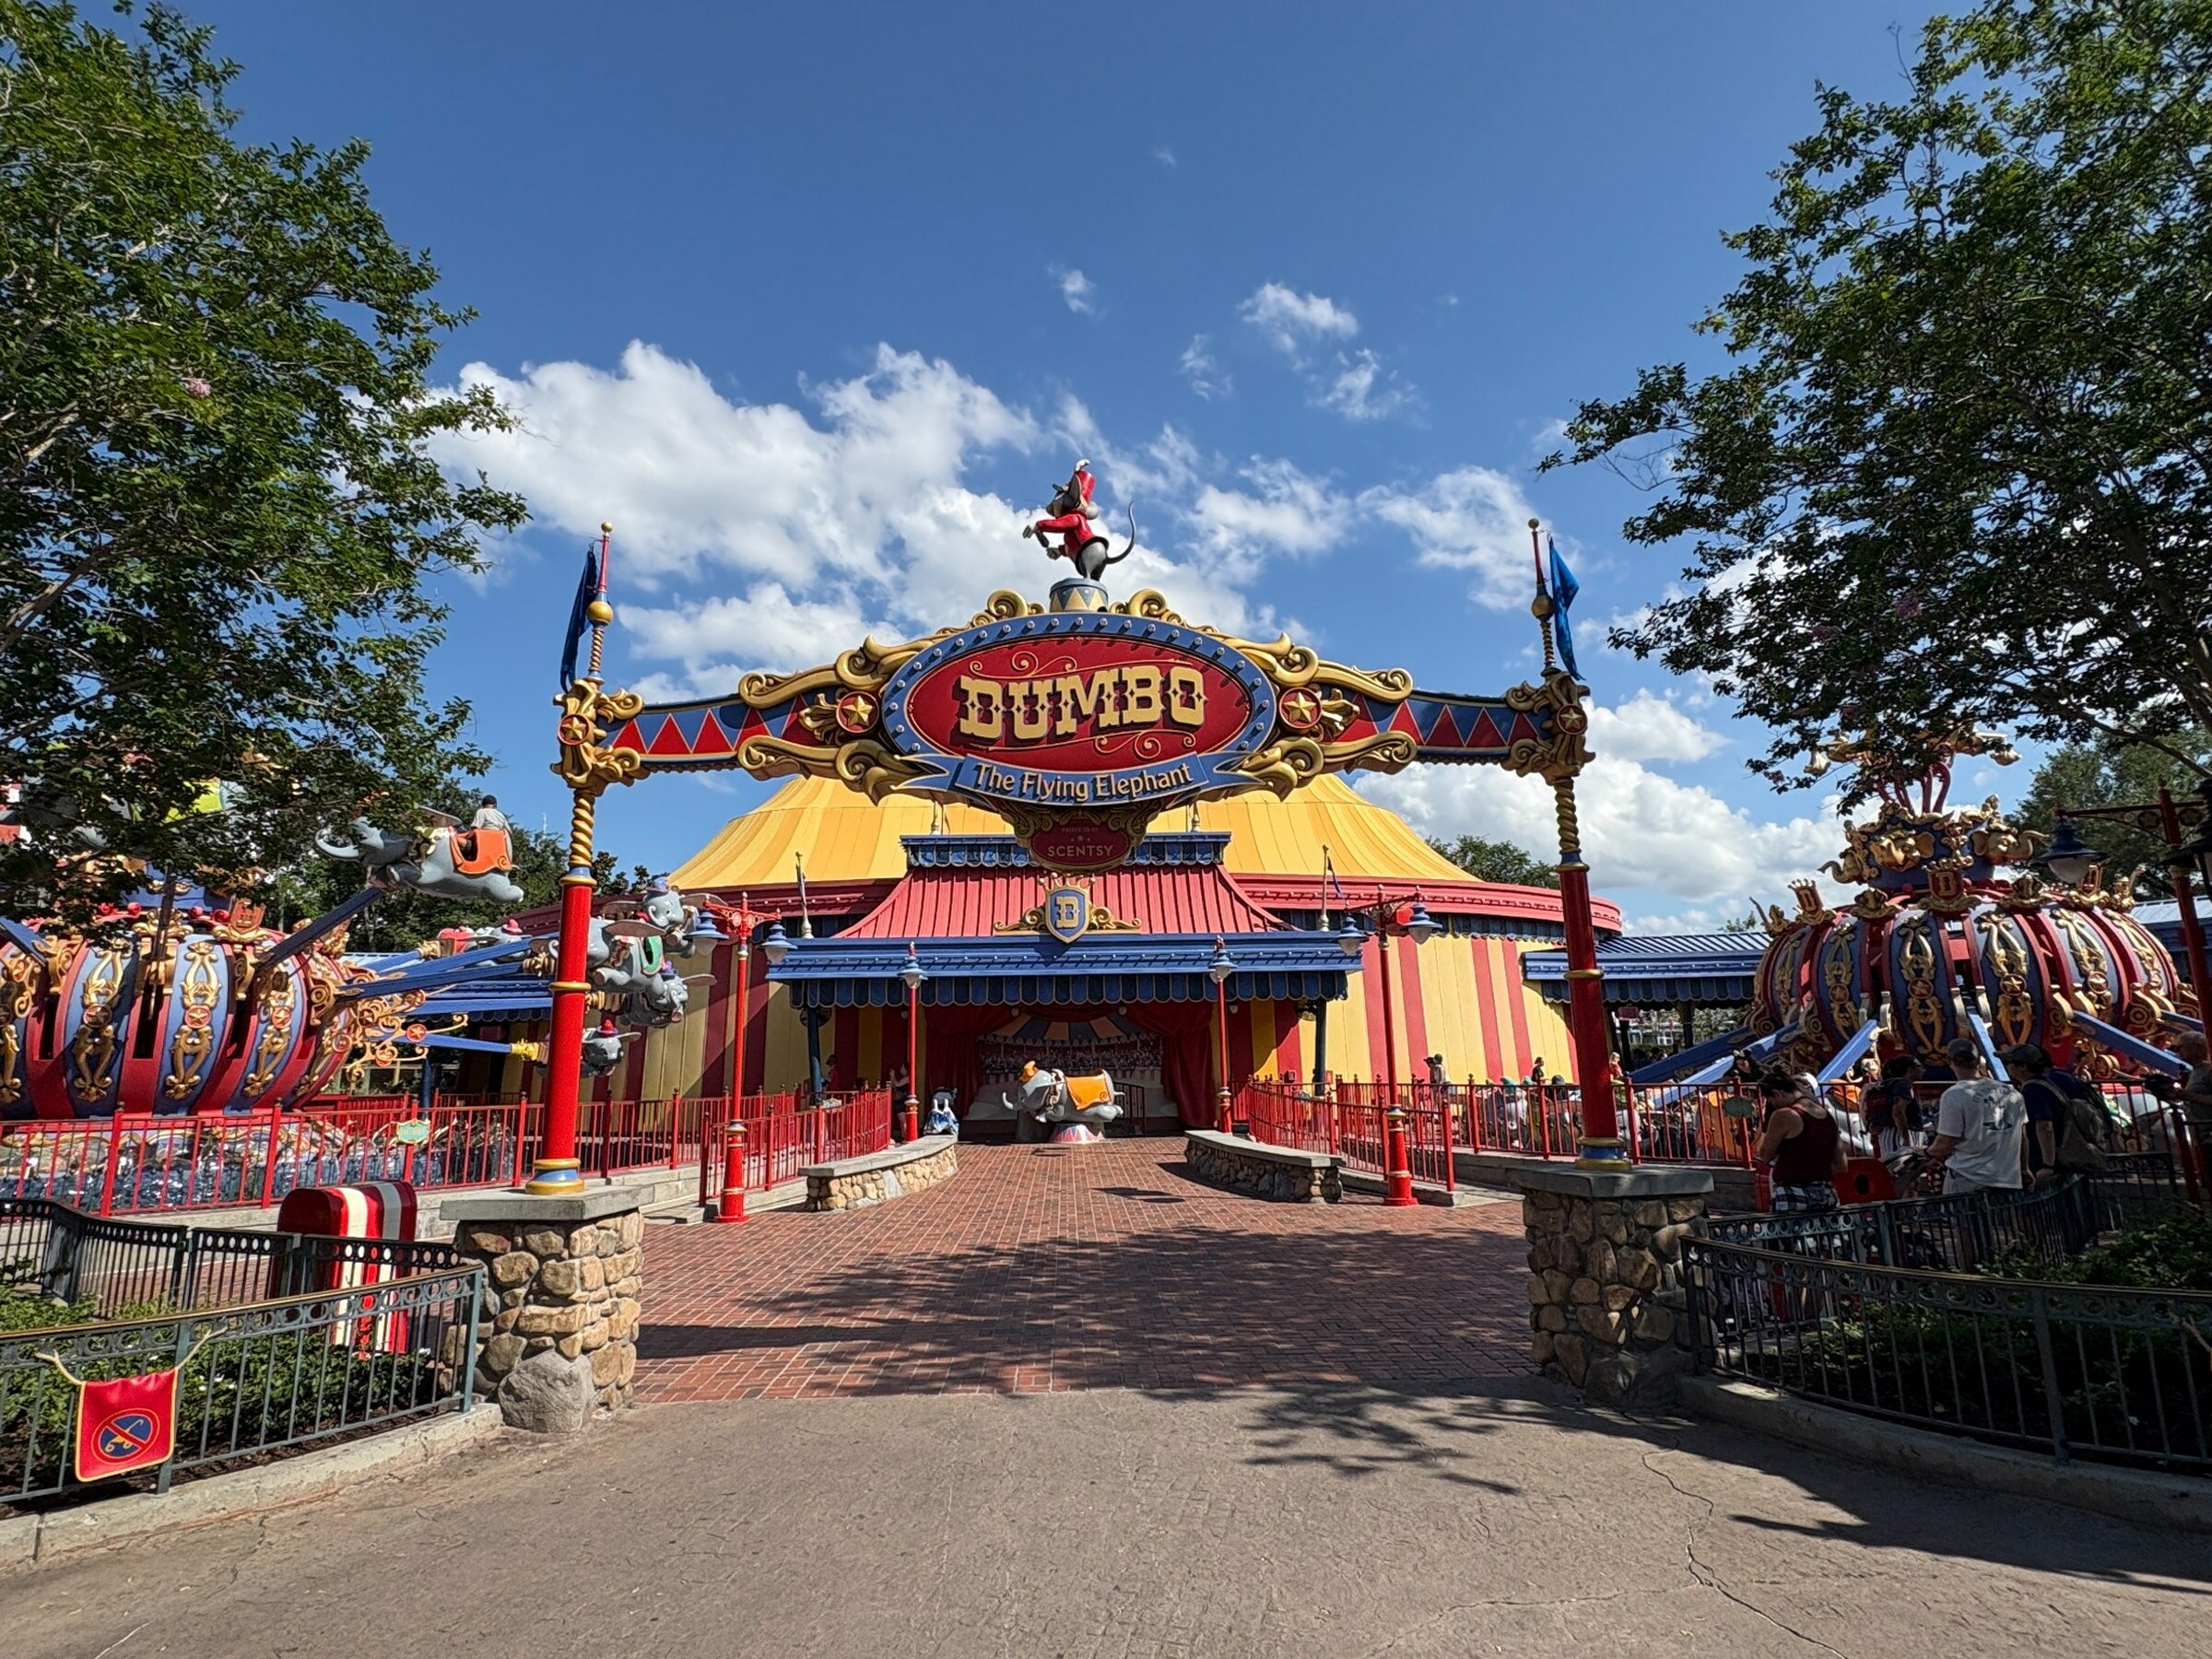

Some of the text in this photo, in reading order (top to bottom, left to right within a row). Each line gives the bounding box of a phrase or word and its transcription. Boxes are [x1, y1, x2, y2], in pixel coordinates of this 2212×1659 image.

[959, 665, 1207, 739] DUMBO
[975, 763, 1194, 801] The Flying Elephant
[1047, 845, 1113, 857] SCENTSY
[1937, 871, 1959, 897] D
[1055, 896, 1080, 929] D
[1799, 888, 1818, 912] D
